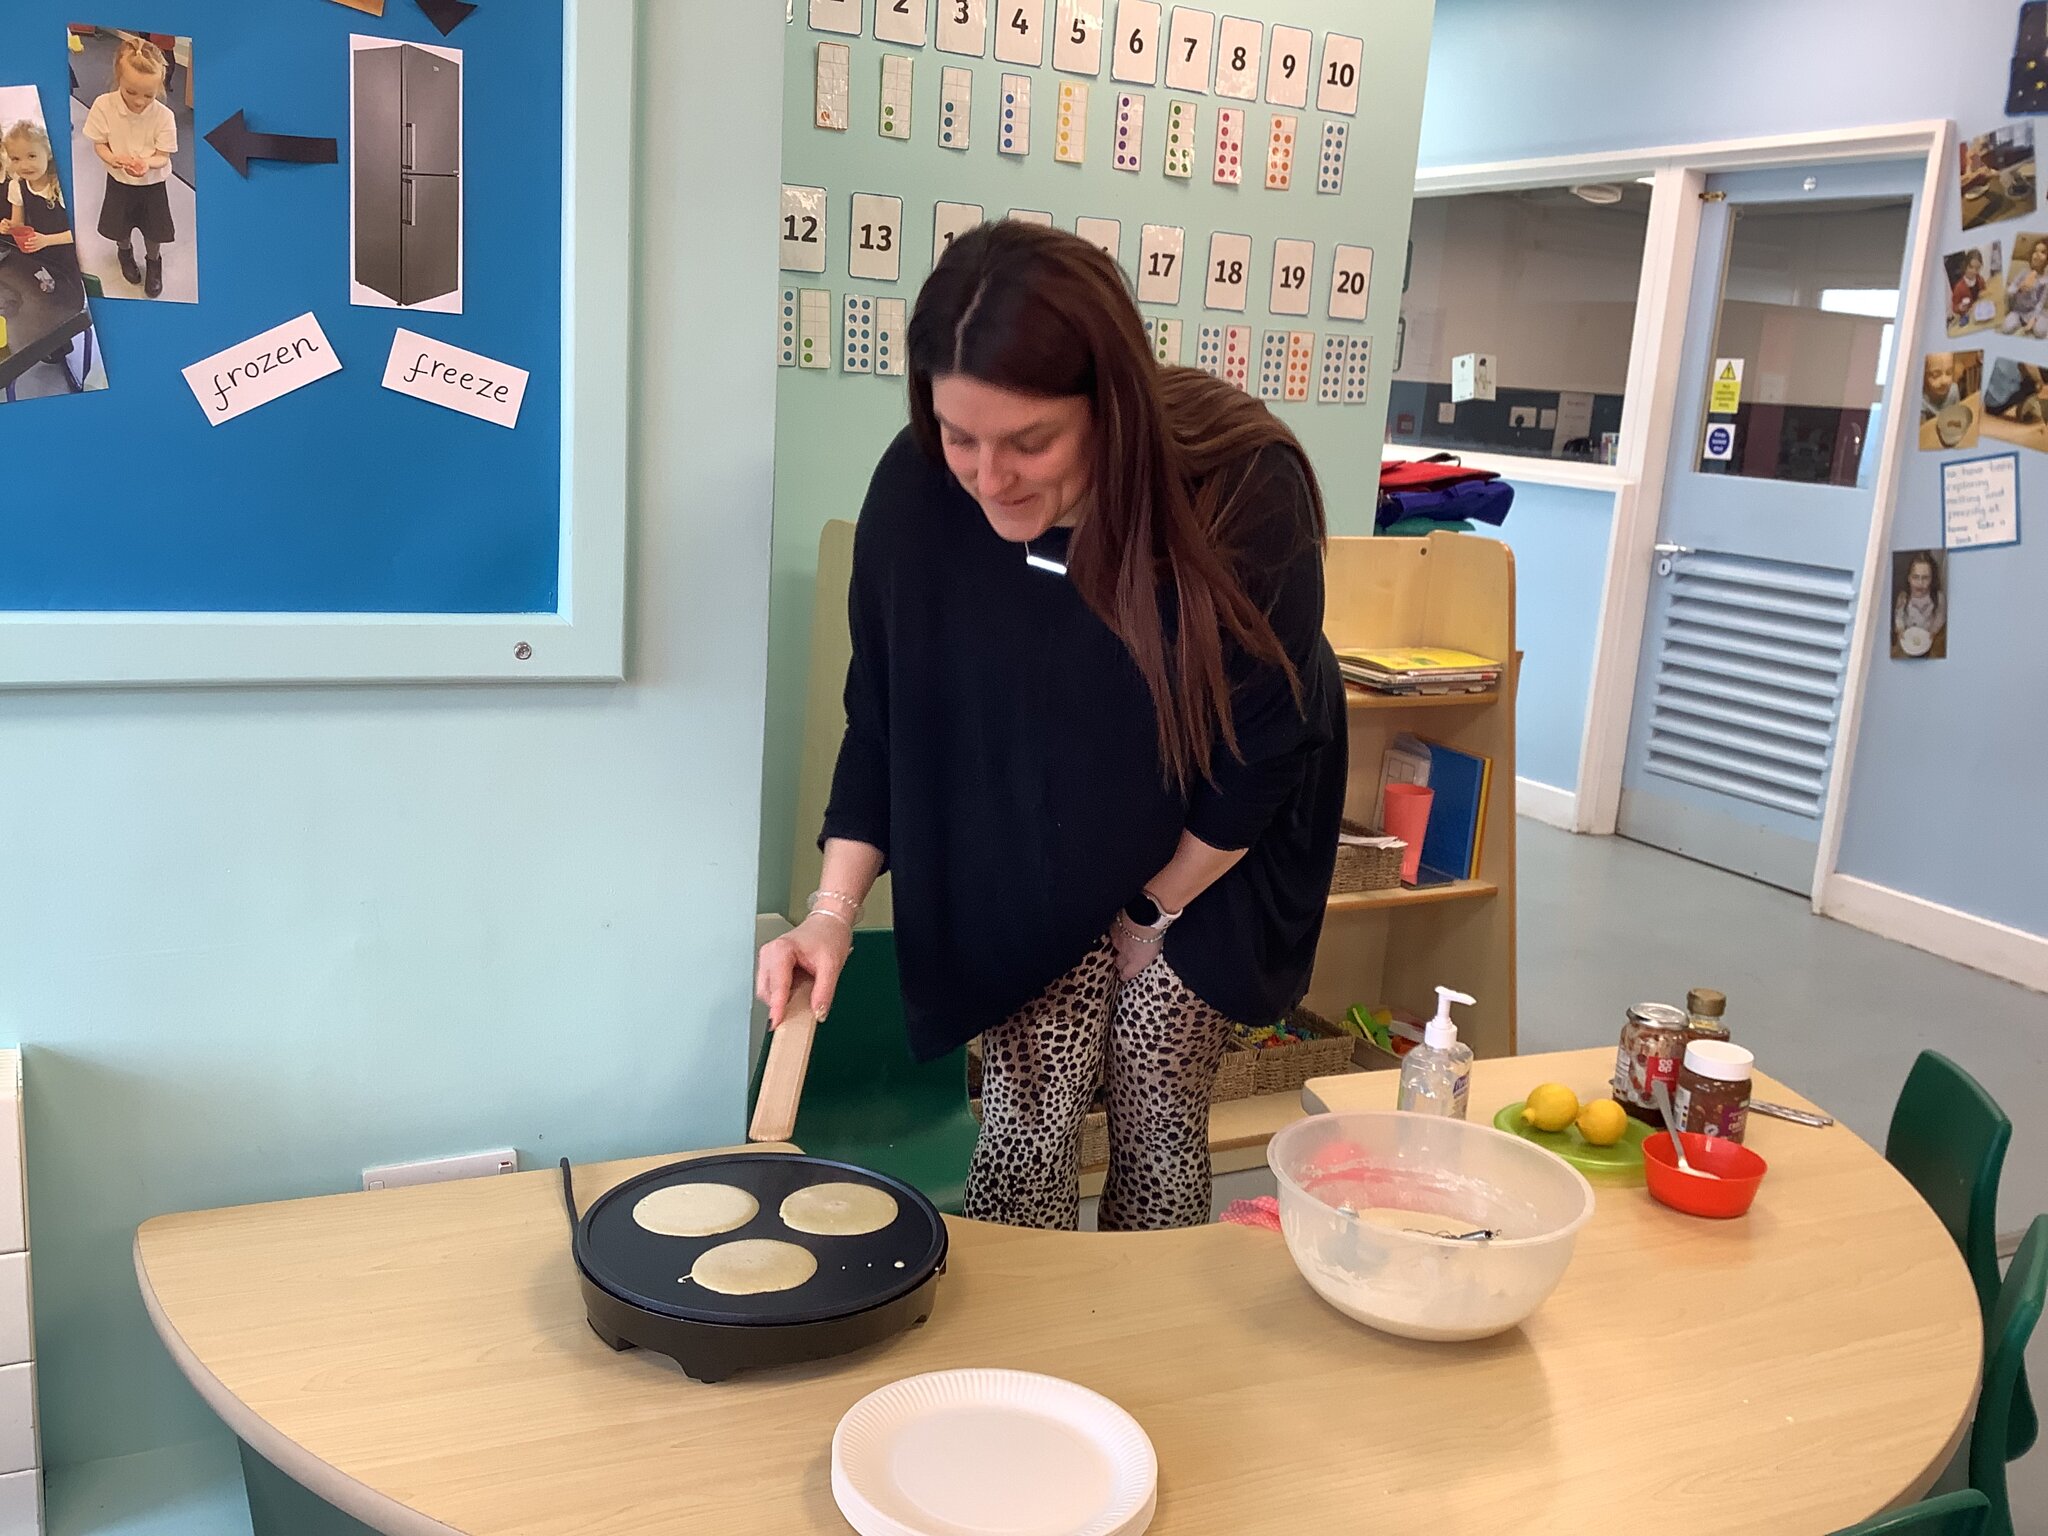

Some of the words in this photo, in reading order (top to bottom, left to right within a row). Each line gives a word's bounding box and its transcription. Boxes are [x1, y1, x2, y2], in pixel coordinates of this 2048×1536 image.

[953, 0, 969, 24] 3
[1011, 8, 1029, 35] 4
[1070, 18, 1086, 44] 5
[1129, 28, 1144, 54] 6
[1183, 37, 1198, 63] 7
[1231, 46, 1247, 71] 8
[1282, 54, 1296, 79] 9
[1326, 61, 1355, 88] 10
[783, 214, 818, 243] 12
[859, 223, 892, 252] 13
[1148, 252, 1176, 278] 17
[1214, 259, 1243, 285] 18
[1280, 265, 1306, 290] 19
[1336, 270, 1365, 295] 20
[213, 337, 320, 412] frozen
[403, 353, 509, 403] freeze
